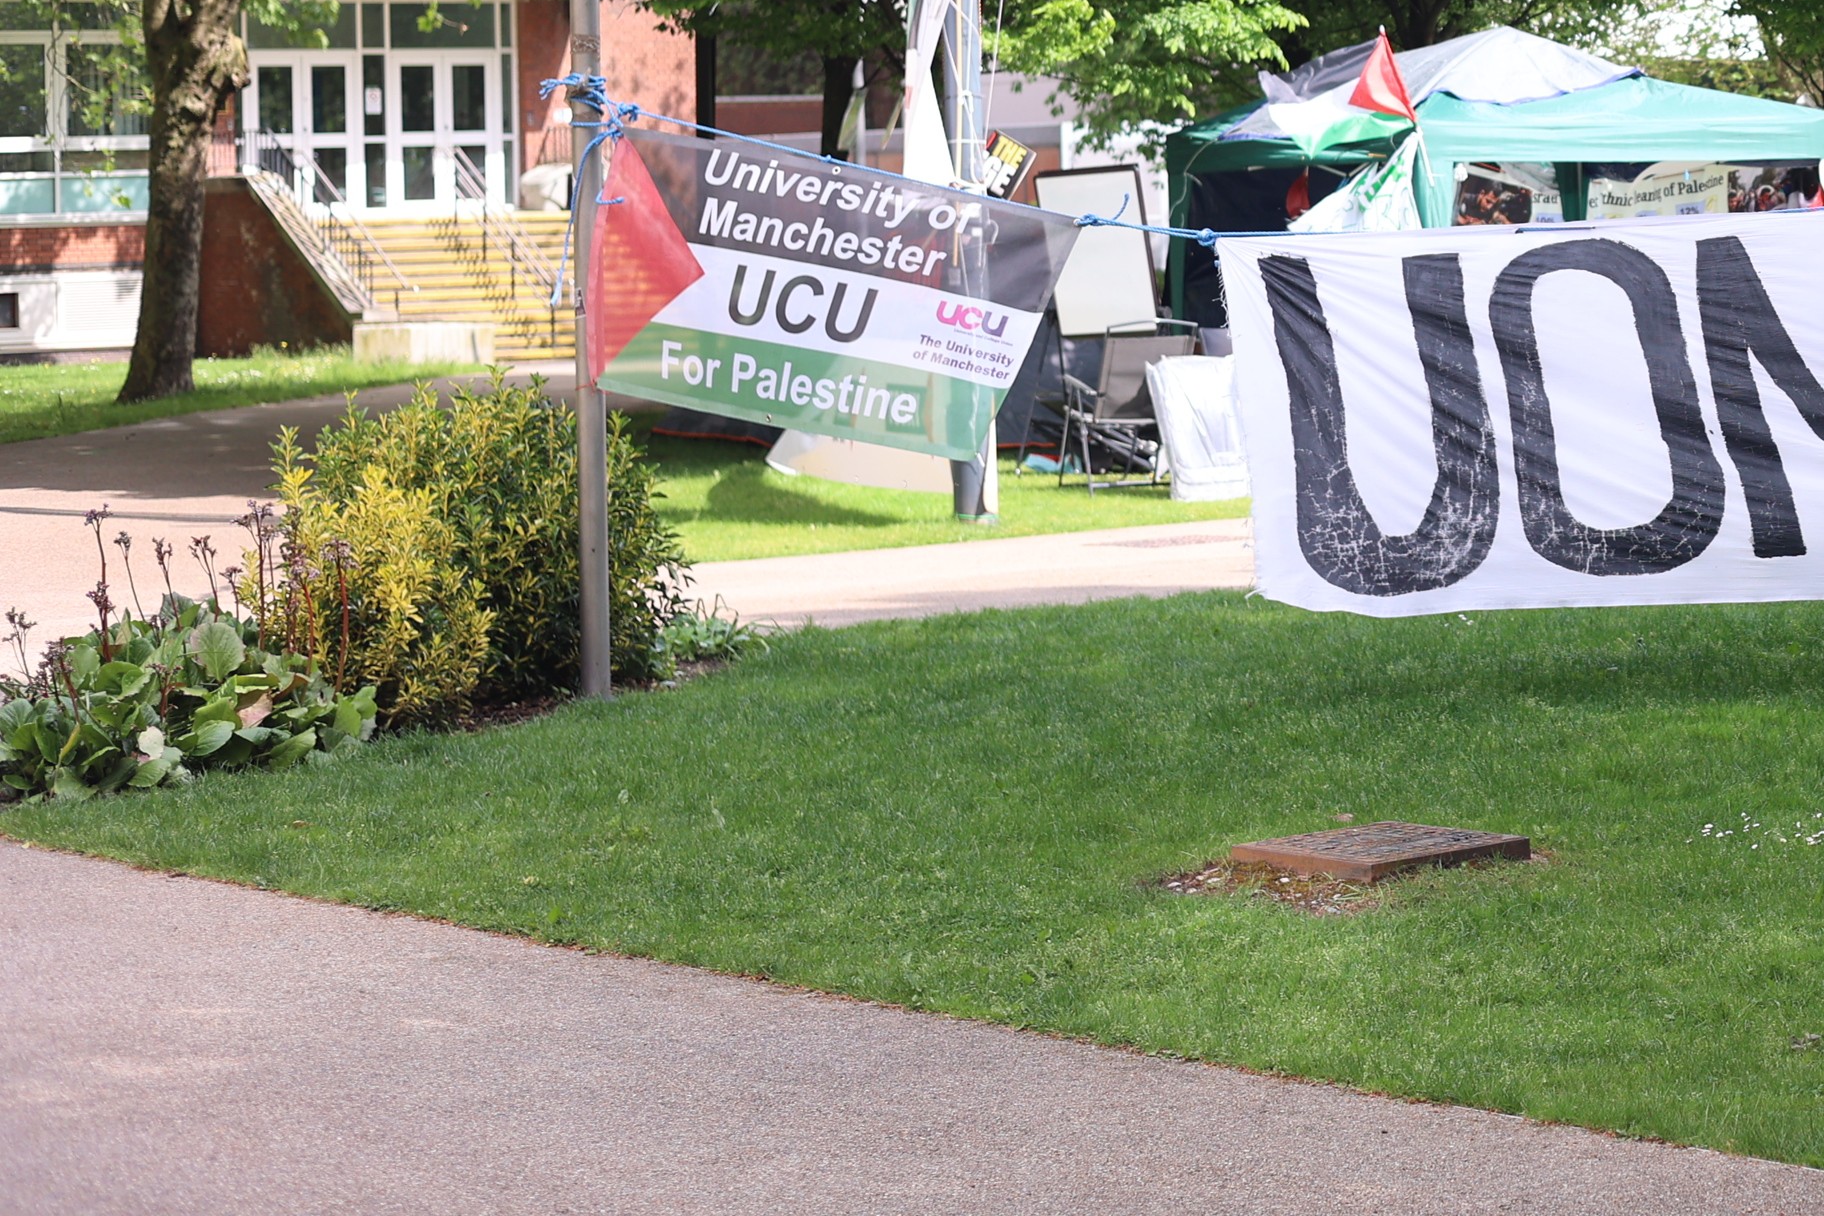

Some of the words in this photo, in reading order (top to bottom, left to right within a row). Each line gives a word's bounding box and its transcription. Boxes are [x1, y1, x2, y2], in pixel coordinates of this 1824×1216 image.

[992, 135, 1028, 170] THE
[703, 149, 918, 229] University
[930, 200, 983, 234] of
[1663, 182, 1675, 197] of
[698, 197, 948, 277] Manchester
[727, 264, 879, 344] UCU
[912, 350, 929, 361] of
[930, 352, 1010, 381] Manchester
[920, 334, 942, 349] The
[946, 340, 1015, 368] University
[660, 339, 721, 389] For
[732, 354, 918, 425] Palestine
